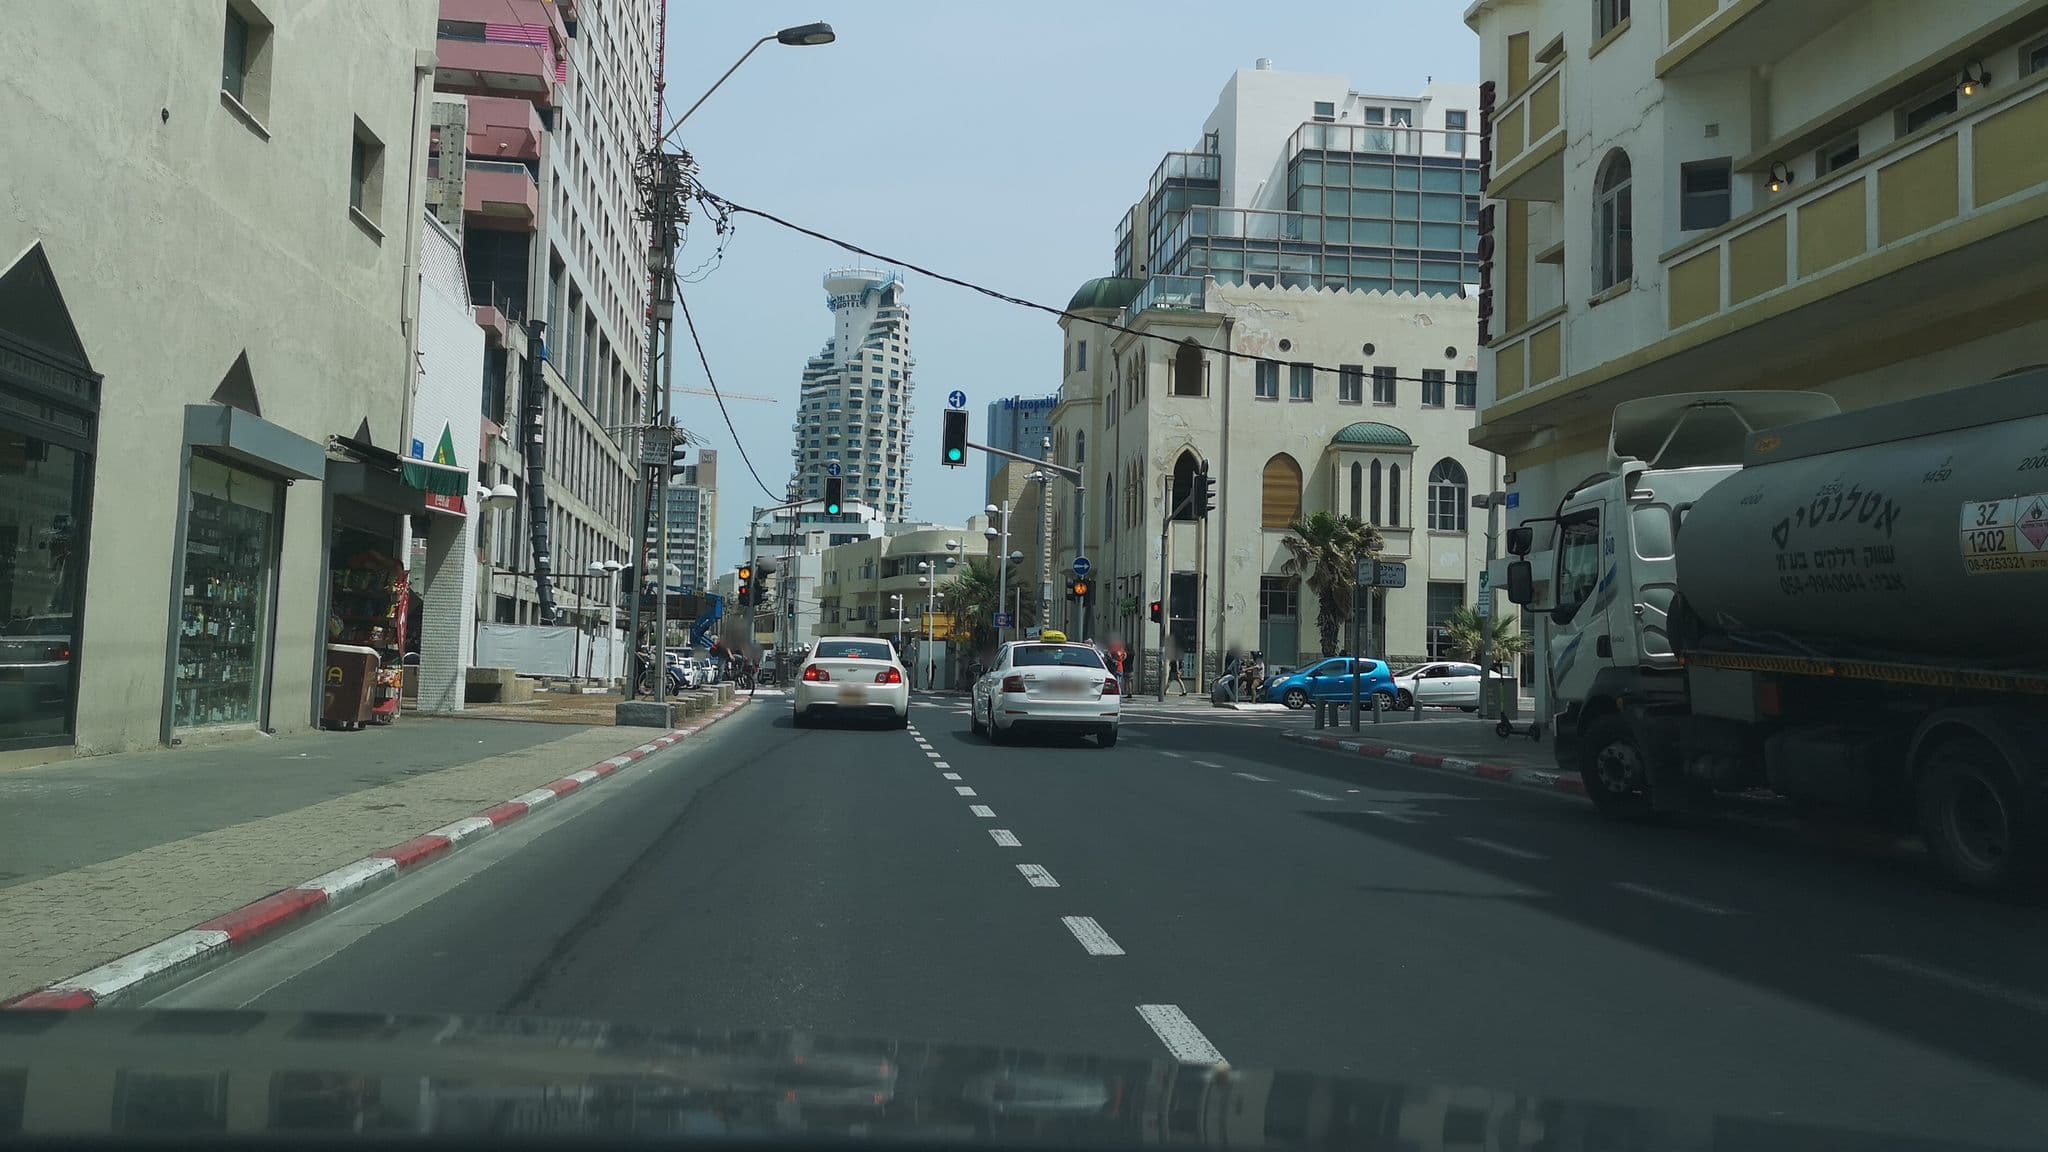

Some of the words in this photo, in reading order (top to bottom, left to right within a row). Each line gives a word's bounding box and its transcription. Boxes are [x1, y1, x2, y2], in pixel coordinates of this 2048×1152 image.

[1479, 81, 1496, 192] BELL
[1477, 204, 1495, 346] HOTEL
[1968, 530, 2007, 553] 1202
[1976, 503, 2000, 527] 3Z
